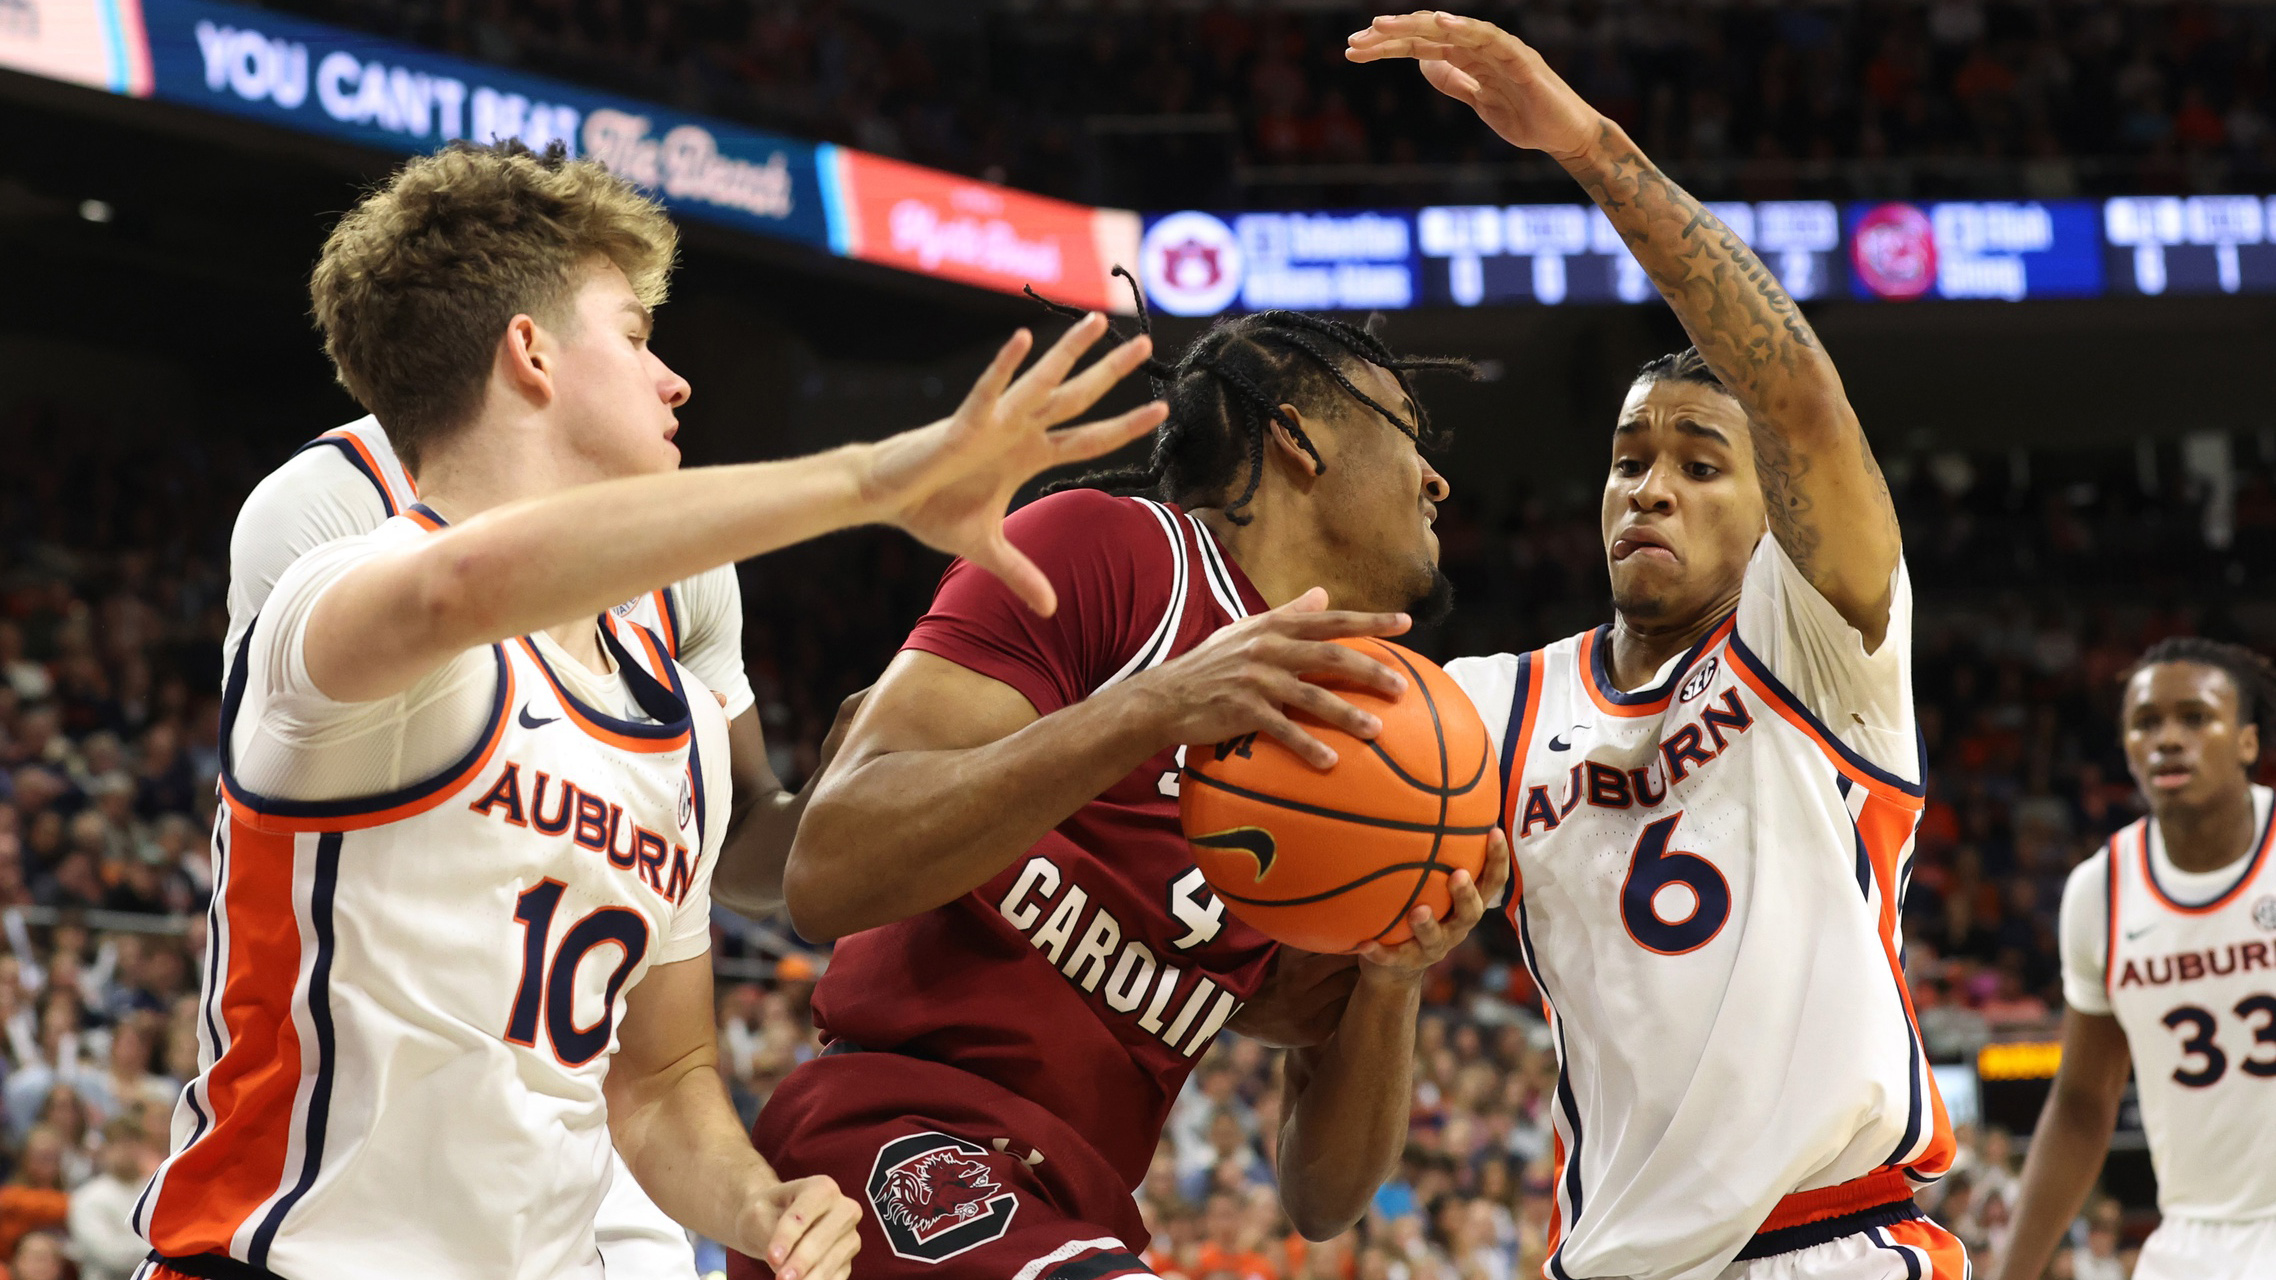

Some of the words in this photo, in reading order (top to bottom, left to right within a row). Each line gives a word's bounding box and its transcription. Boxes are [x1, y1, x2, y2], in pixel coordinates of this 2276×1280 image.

[195, 18, 309, 110] YOU
[1682, 659, 1715, 701] SEC
[1520, 685, 1754, 839] AUBURN
[468, 760, 701, 907] AUBURN
[1619, 810, 1732, 956] 6
[1169, 864, 1227, 952] 4
[502, 875, 650, 1069] 10
[2161, 993, 2276, 1089] 33
